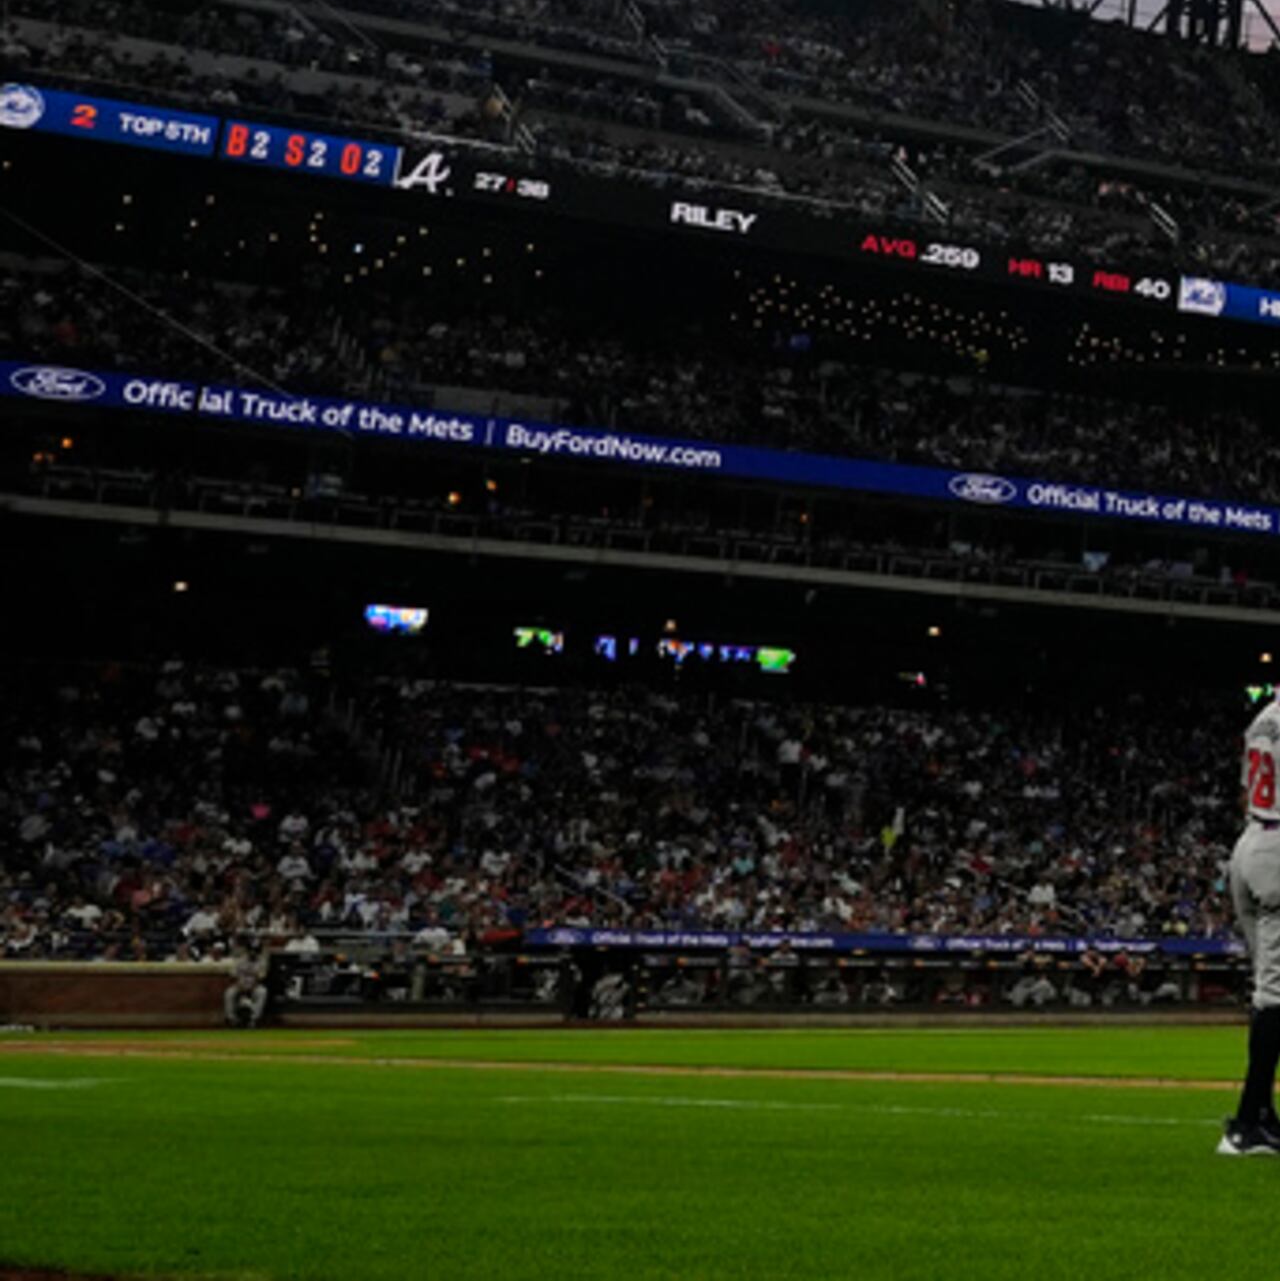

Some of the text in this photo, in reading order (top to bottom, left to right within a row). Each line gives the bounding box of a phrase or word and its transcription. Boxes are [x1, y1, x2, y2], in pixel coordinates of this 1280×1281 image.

[72, 105, 96, 128] 2
[119, 112, 162, 135] TOP
[227, 125, 248, 156] B
[248, 132, 270, 158] 2
[285, 135, 305, 165] S
[308, 141, 326, 166] 2
[364, 150, 382, 176] 2
[475, 173, 509, 190] 27
[671, 203, 755, 232] RILEY
[862, 235, 916, 257] AVG
[1049, 264, 1073, 283] 13
[1135, 278, 1170, 298] 40
[124, 380, 232, 413] Official
[242, 394, 316, 422] Truck
[322, 405, 353, 425] of
[359, 409, 403, 432] the
[409, 414, 473, 440] Mets
[506, 425, 721, 466] BuyFordNow.com
[1027, 484, 1099, 510] Official
[1106, 493, 1158, 516] Truck
[1162, 500, 1185, 519] of
[1189, 504, 1221, 523] the
[1226, 508, 1271, 530] Mets
